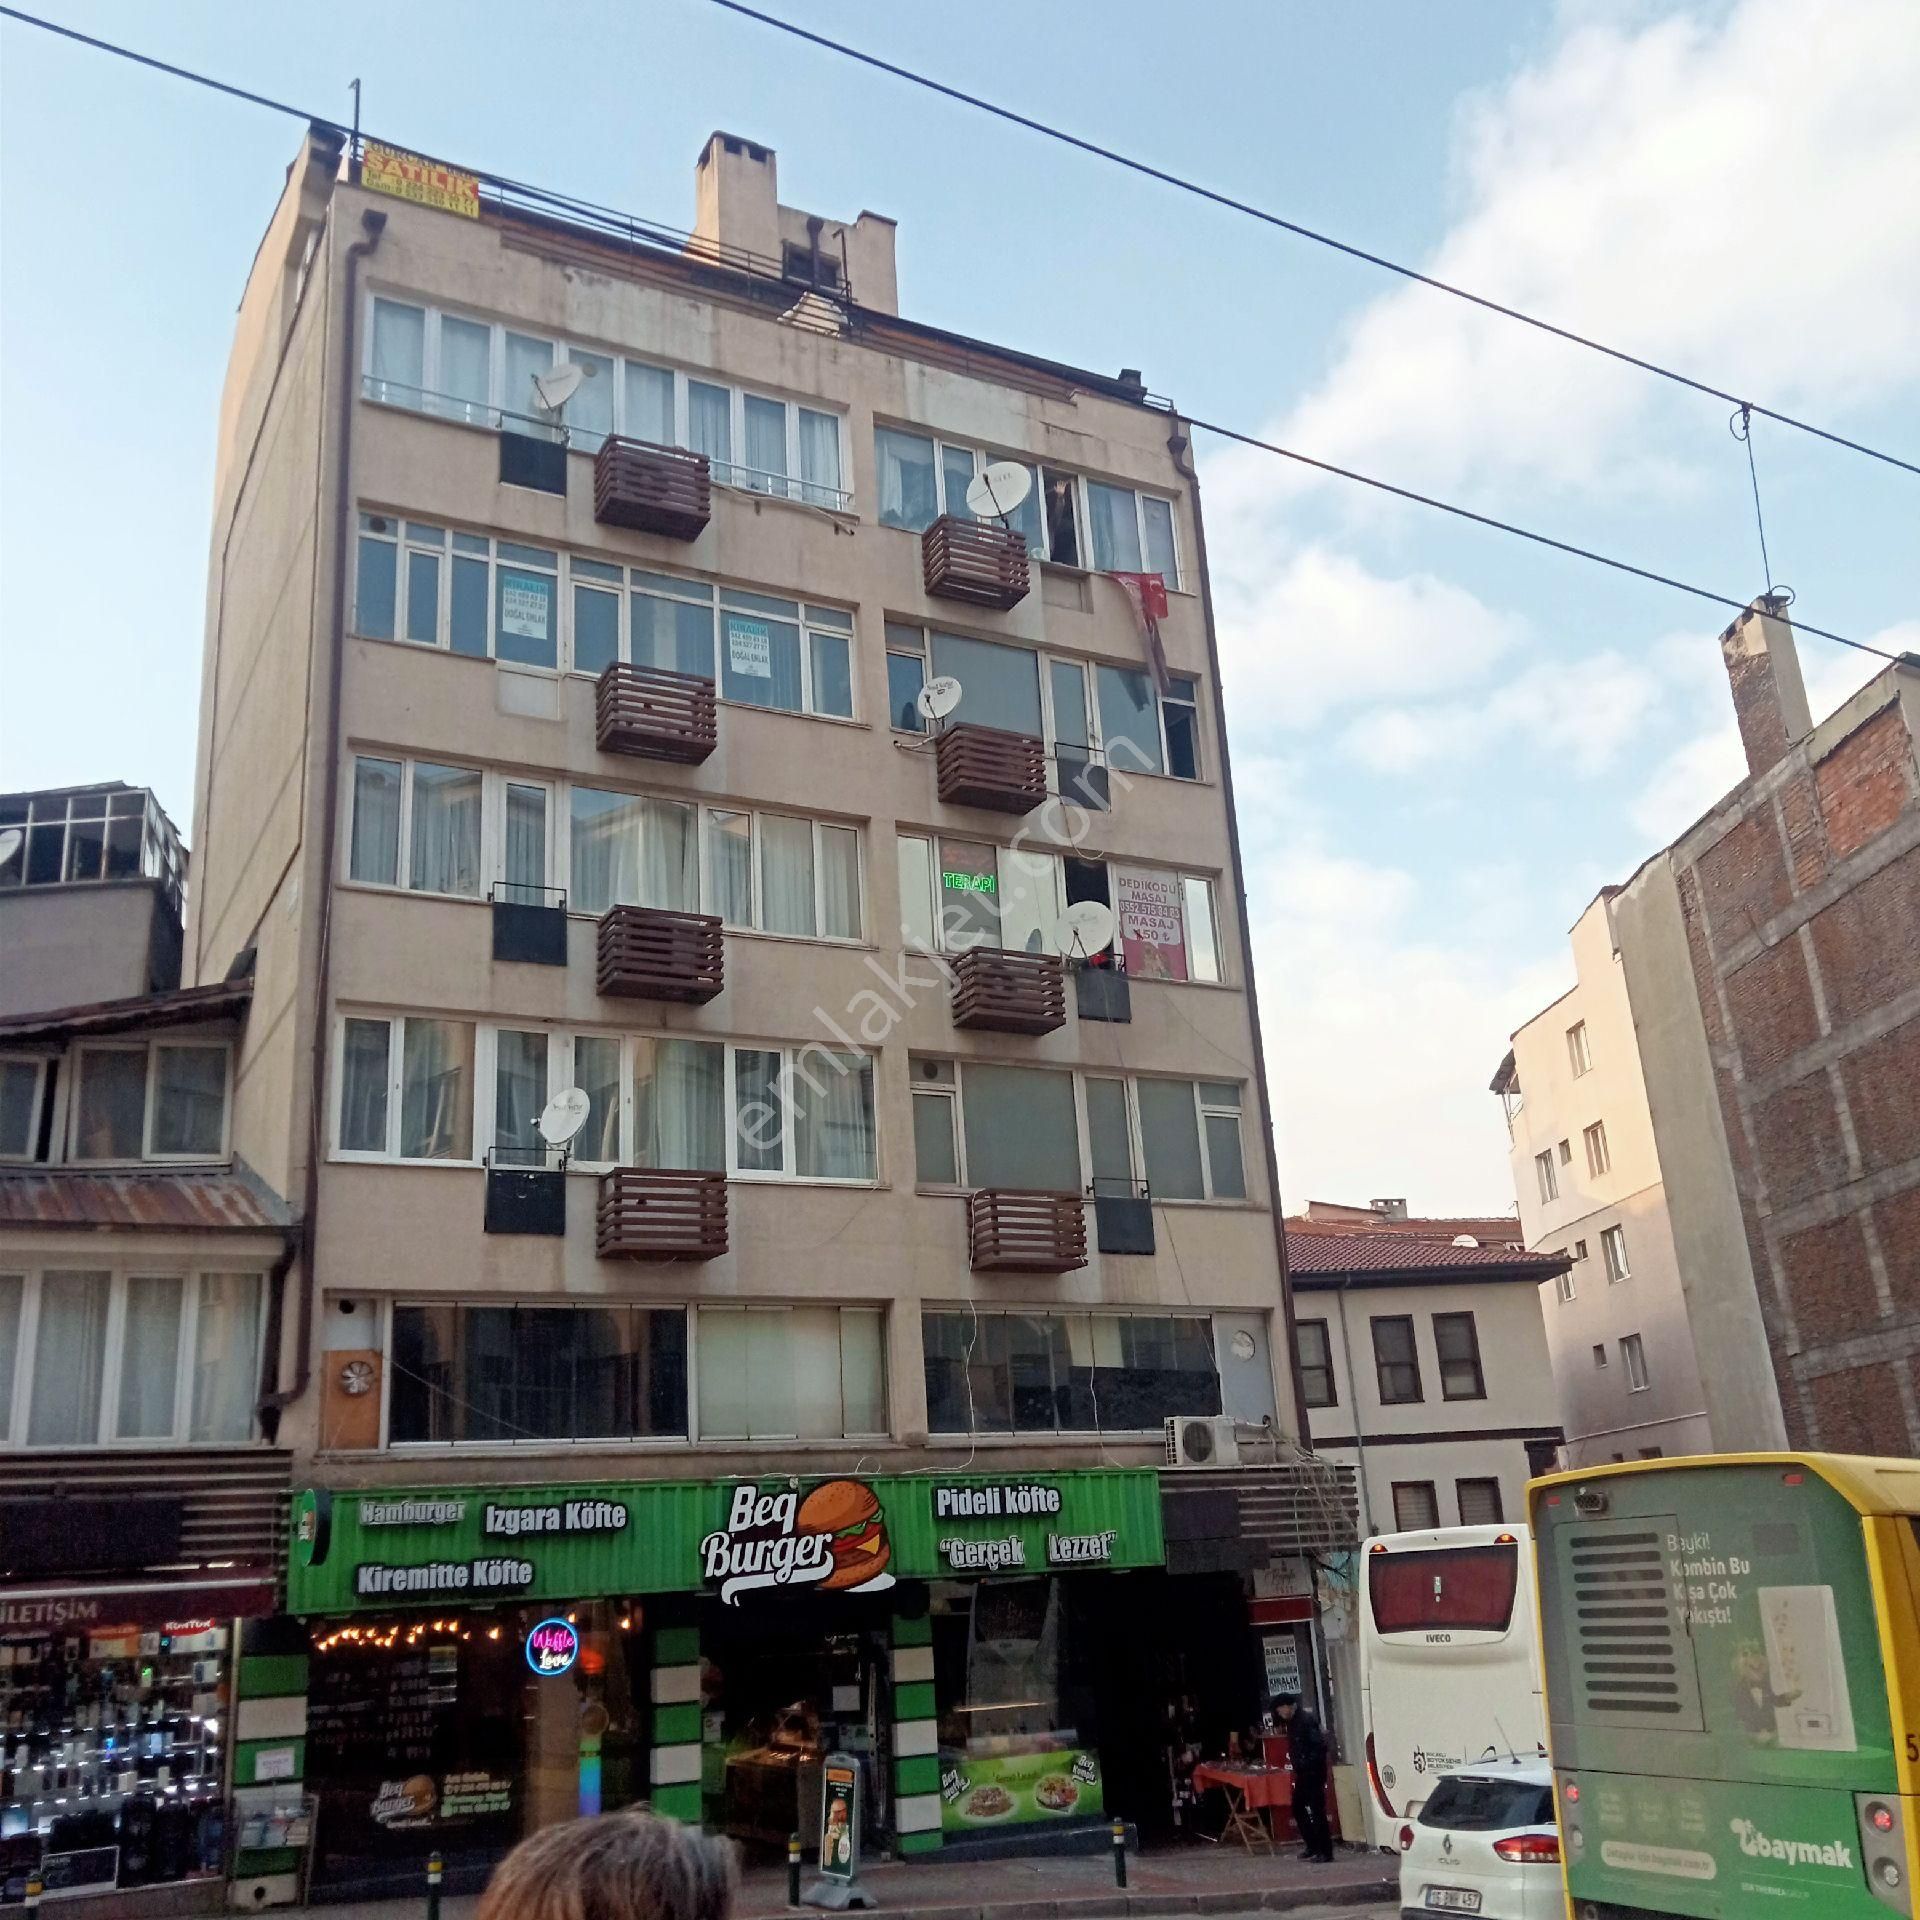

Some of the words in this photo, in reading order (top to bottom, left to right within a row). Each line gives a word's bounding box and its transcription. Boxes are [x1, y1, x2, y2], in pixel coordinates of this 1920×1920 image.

[1120, 901, 1140, 913] 0552
[1141, 903, 1156, 915] 575
[1131, 890, 1167, 904] MASAJ
[1128, 915, 1174, 930] MASAJ
[728, 1486, 798, 1535] Beq
[937, 1488, 1001, 1517] Pideli
[1005, 1485, 1061, 1514] köfte
[361, 1501, 466, 1526] Hamburger
[486, 1504, 560, 1534] Izgara
[566, 1502, 627, 1530] Köfte
[701, 1530, 833, 1583] Burger
[1728, 1557, 1751, 1575] Bu
[358, 1563, 469, 1594] Kiremitte
[473, 1559, 533, 1588] Köfte
[1672, 1582, 1706, 1604] Kşa
[1708, 1580, 1738, 1604] Çok
[533, 1628, 575, 1651] Waffle
[1426, 1633, 1451, 1643] IVECO
[539, 1647, 573, 1669] Love
[1906, 1733, 1920, 1763] 5
[1758, 1830, 1854, 1869] baymak
